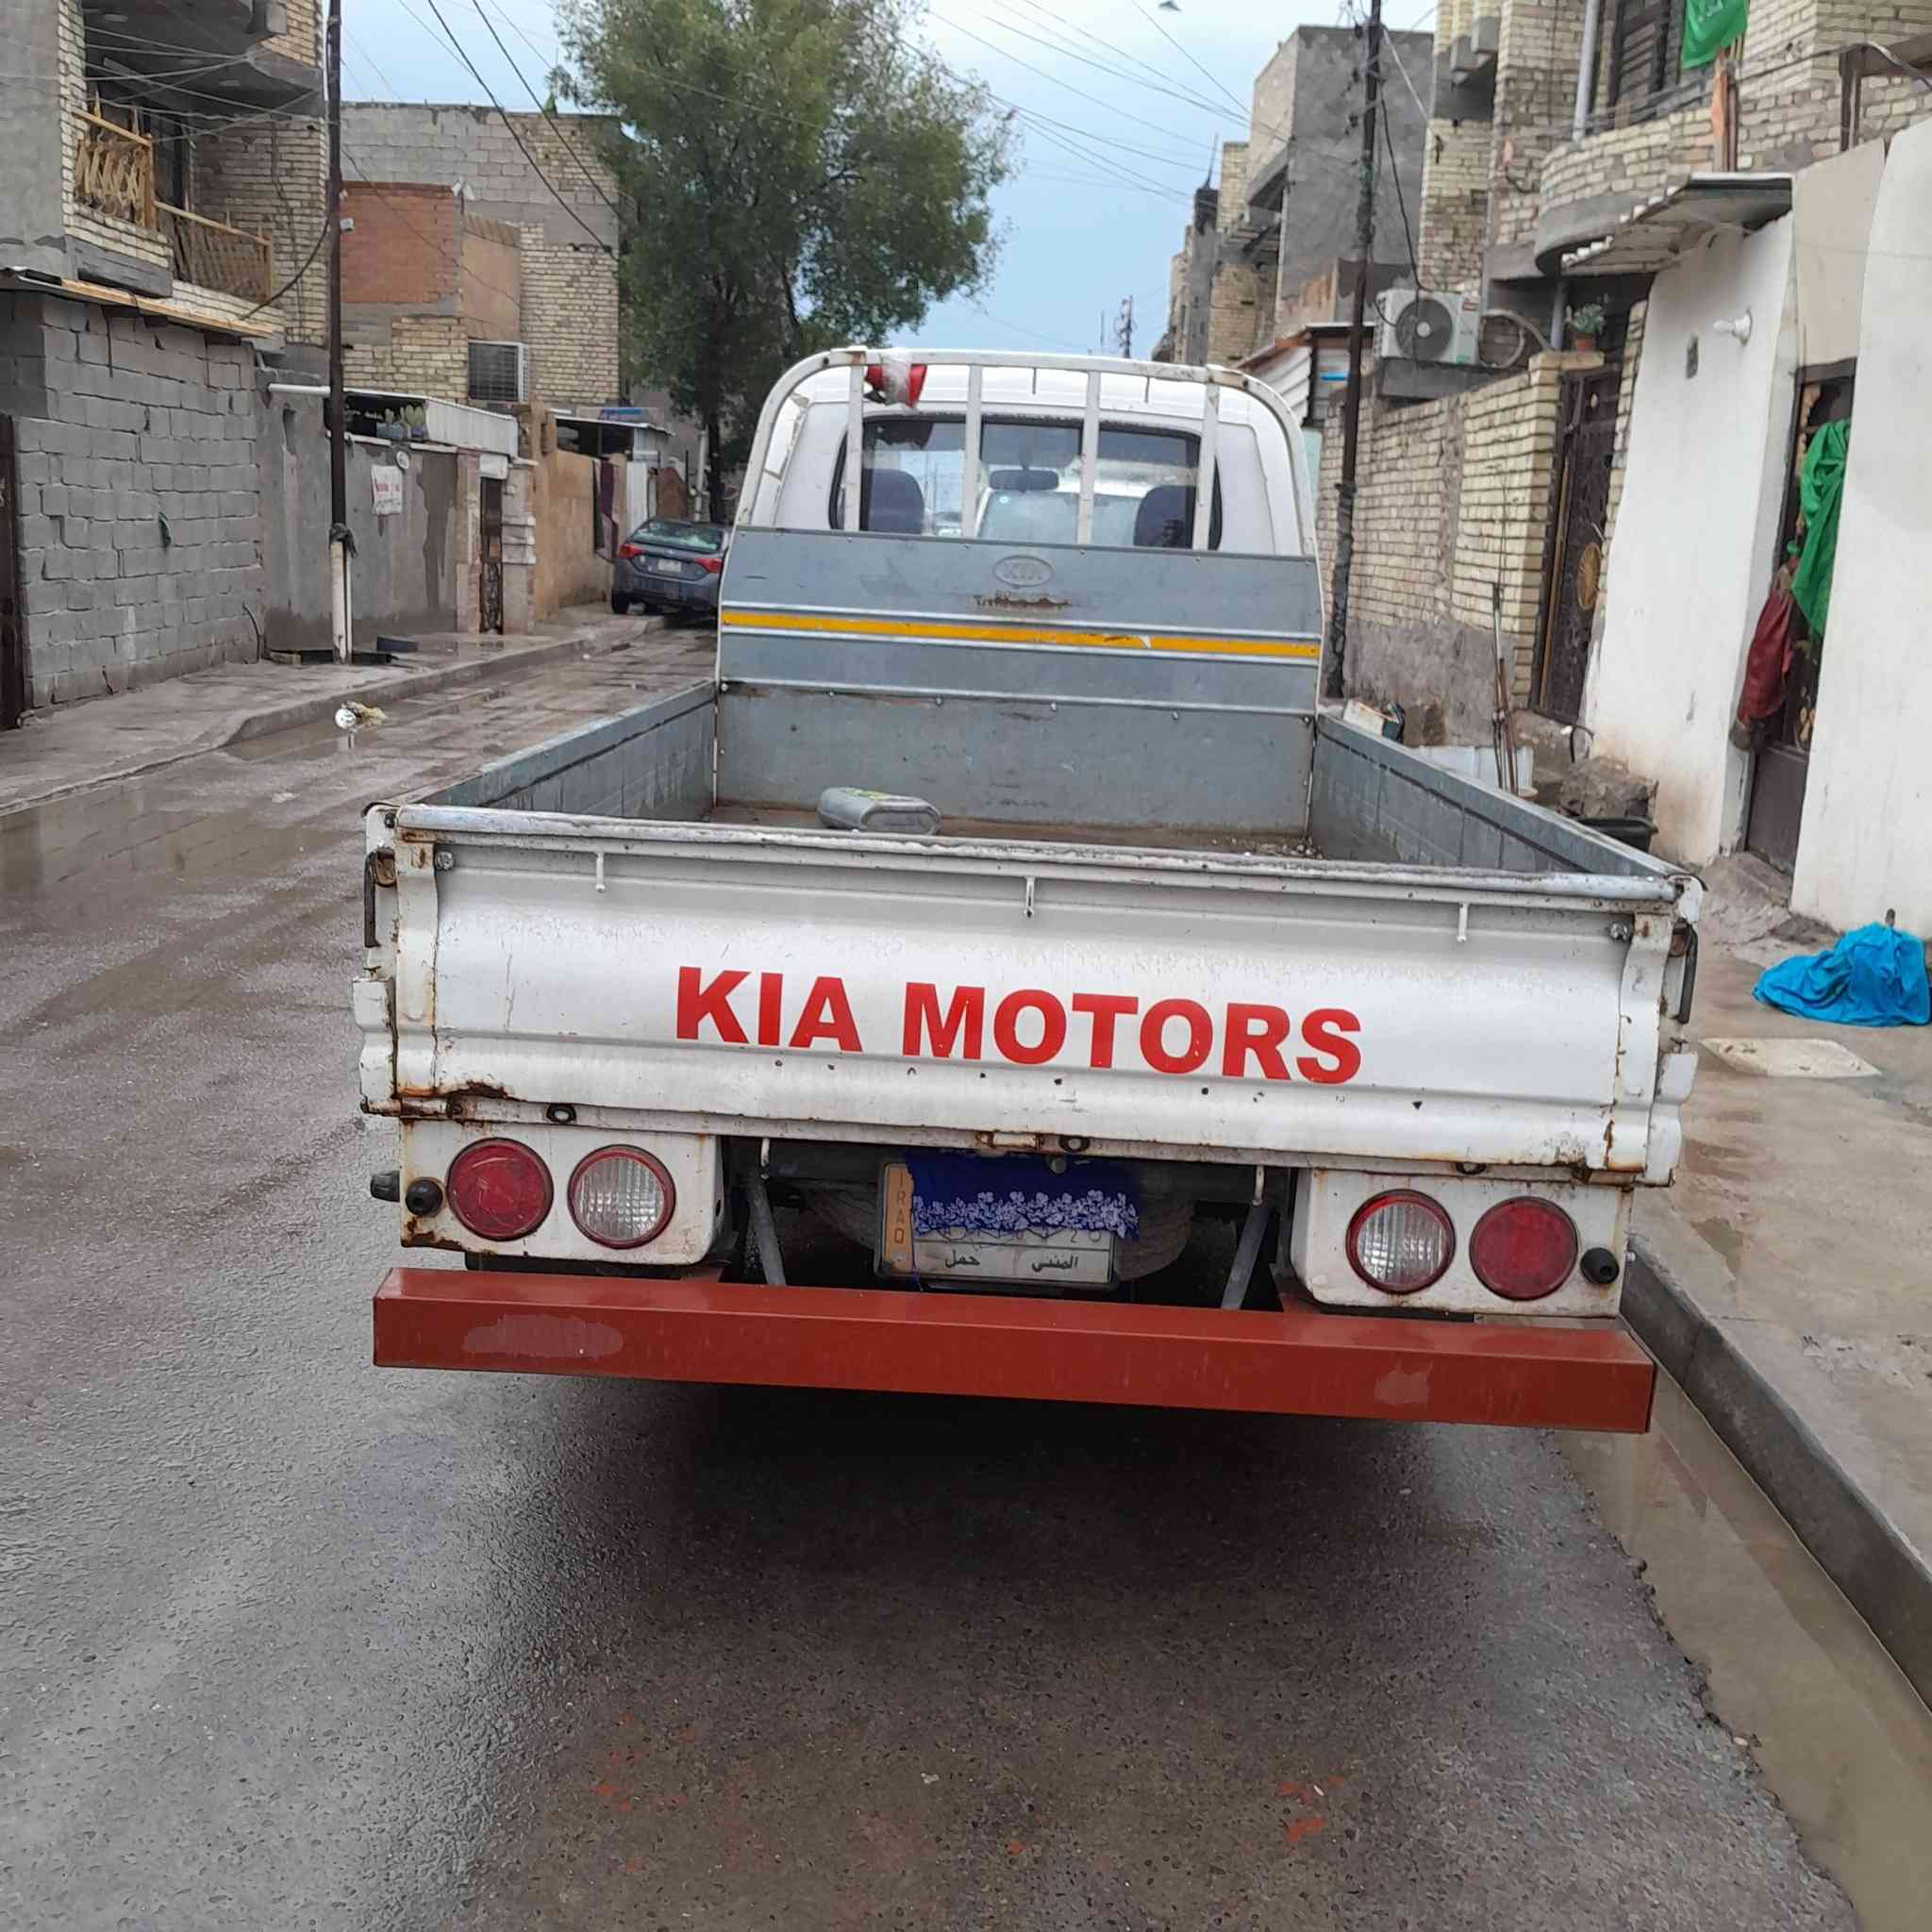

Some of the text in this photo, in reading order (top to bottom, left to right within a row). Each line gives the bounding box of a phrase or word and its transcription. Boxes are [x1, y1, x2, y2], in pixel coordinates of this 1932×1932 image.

[675, 966, 1362, 1084] KIA MOTORS
[893, 1171, 907, 1244] IRAQ
[944, 1249, 980, 1269] حمل
